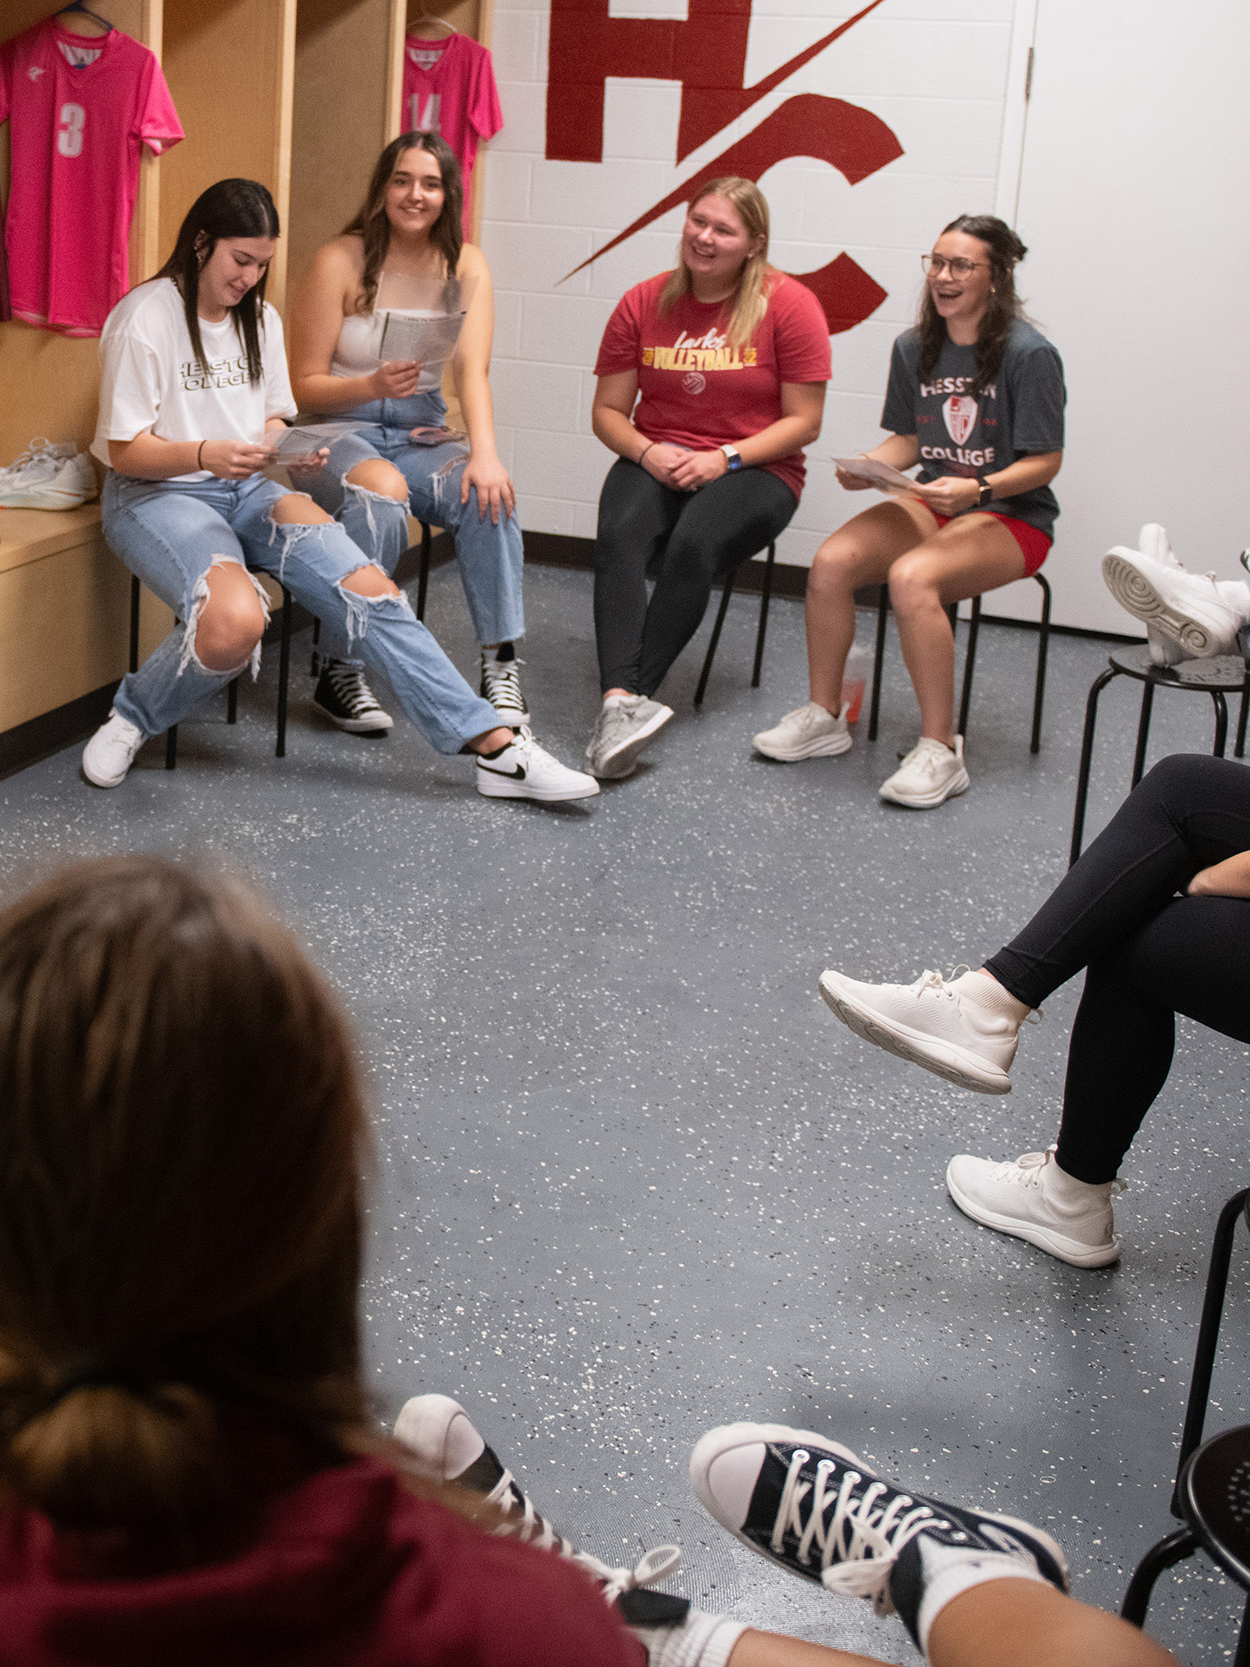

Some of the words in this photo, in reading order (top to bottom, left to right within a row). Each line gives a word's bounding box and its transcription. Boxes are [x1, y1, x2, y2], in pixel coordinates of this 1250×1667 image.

[58, 102, 85, 158] 3
[654, 346, 743, 371] VOLLEYBALL
[920, 445, 995, 467] COLLEGE
